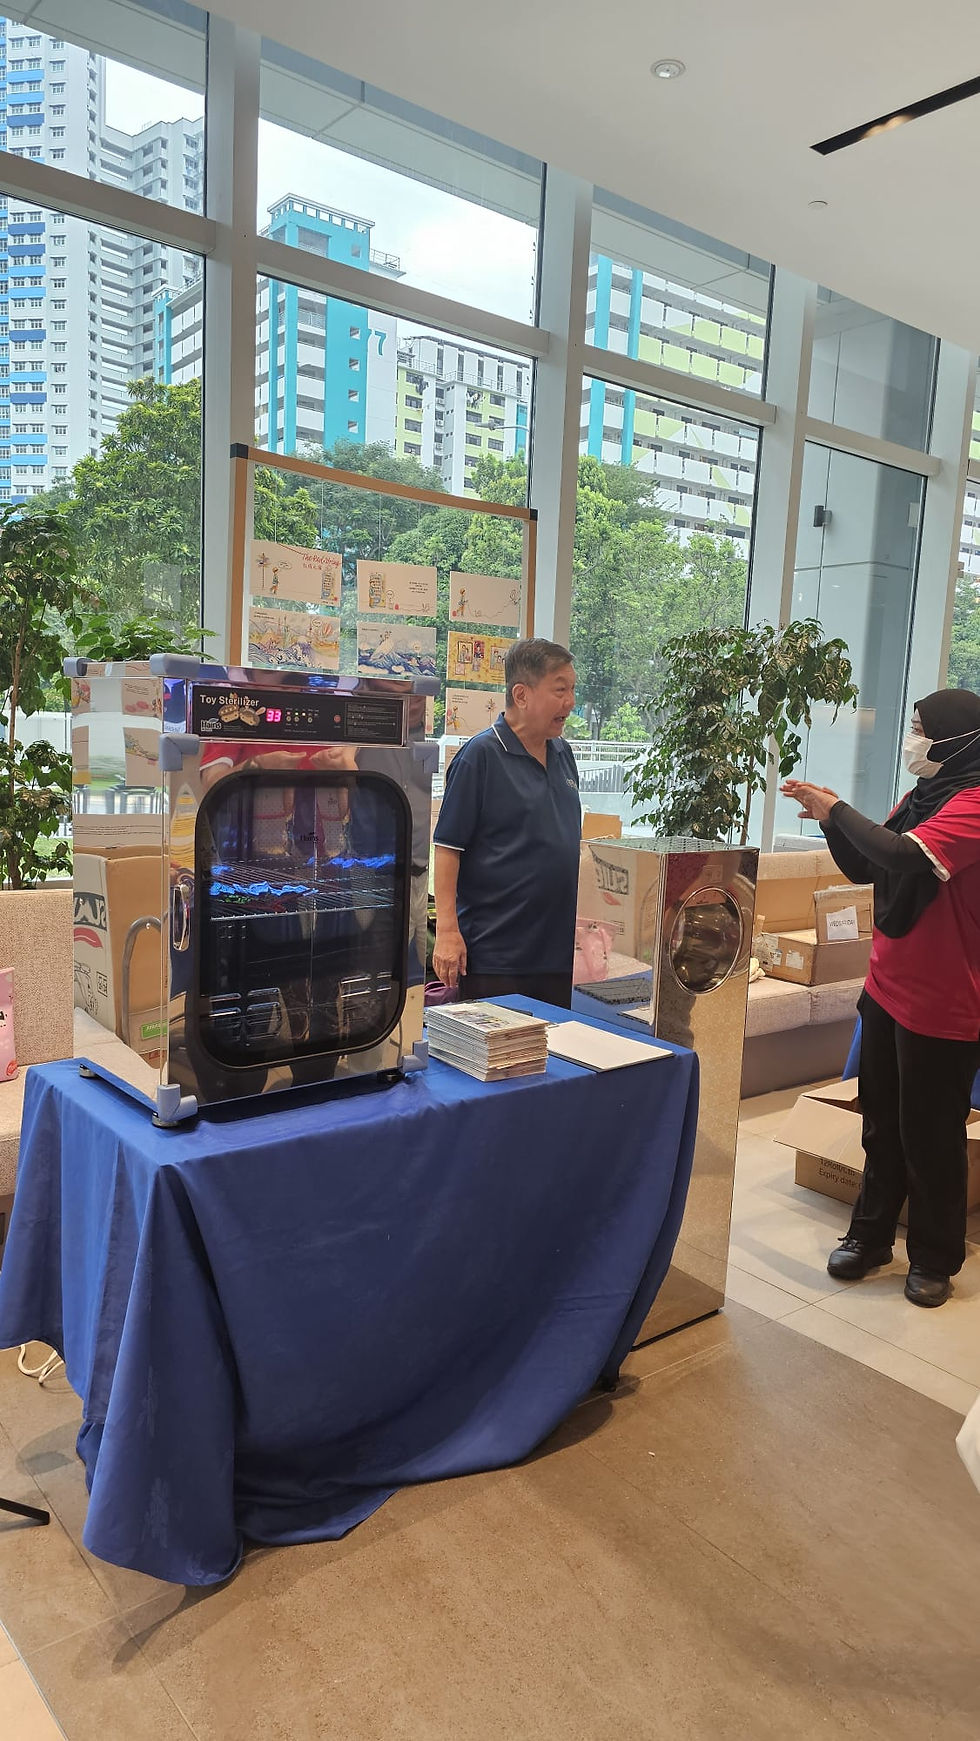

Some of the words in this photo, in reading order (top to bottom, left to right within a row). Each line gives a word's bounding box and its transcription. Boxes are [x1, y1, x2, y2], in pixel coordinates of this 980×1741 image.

[200, 695, 217, 705] Toy
[219, 696, 259, 706] Sterilizer
[266, 710, 281, 722] 33
[819, 1168, 839, 1184] Expiry
